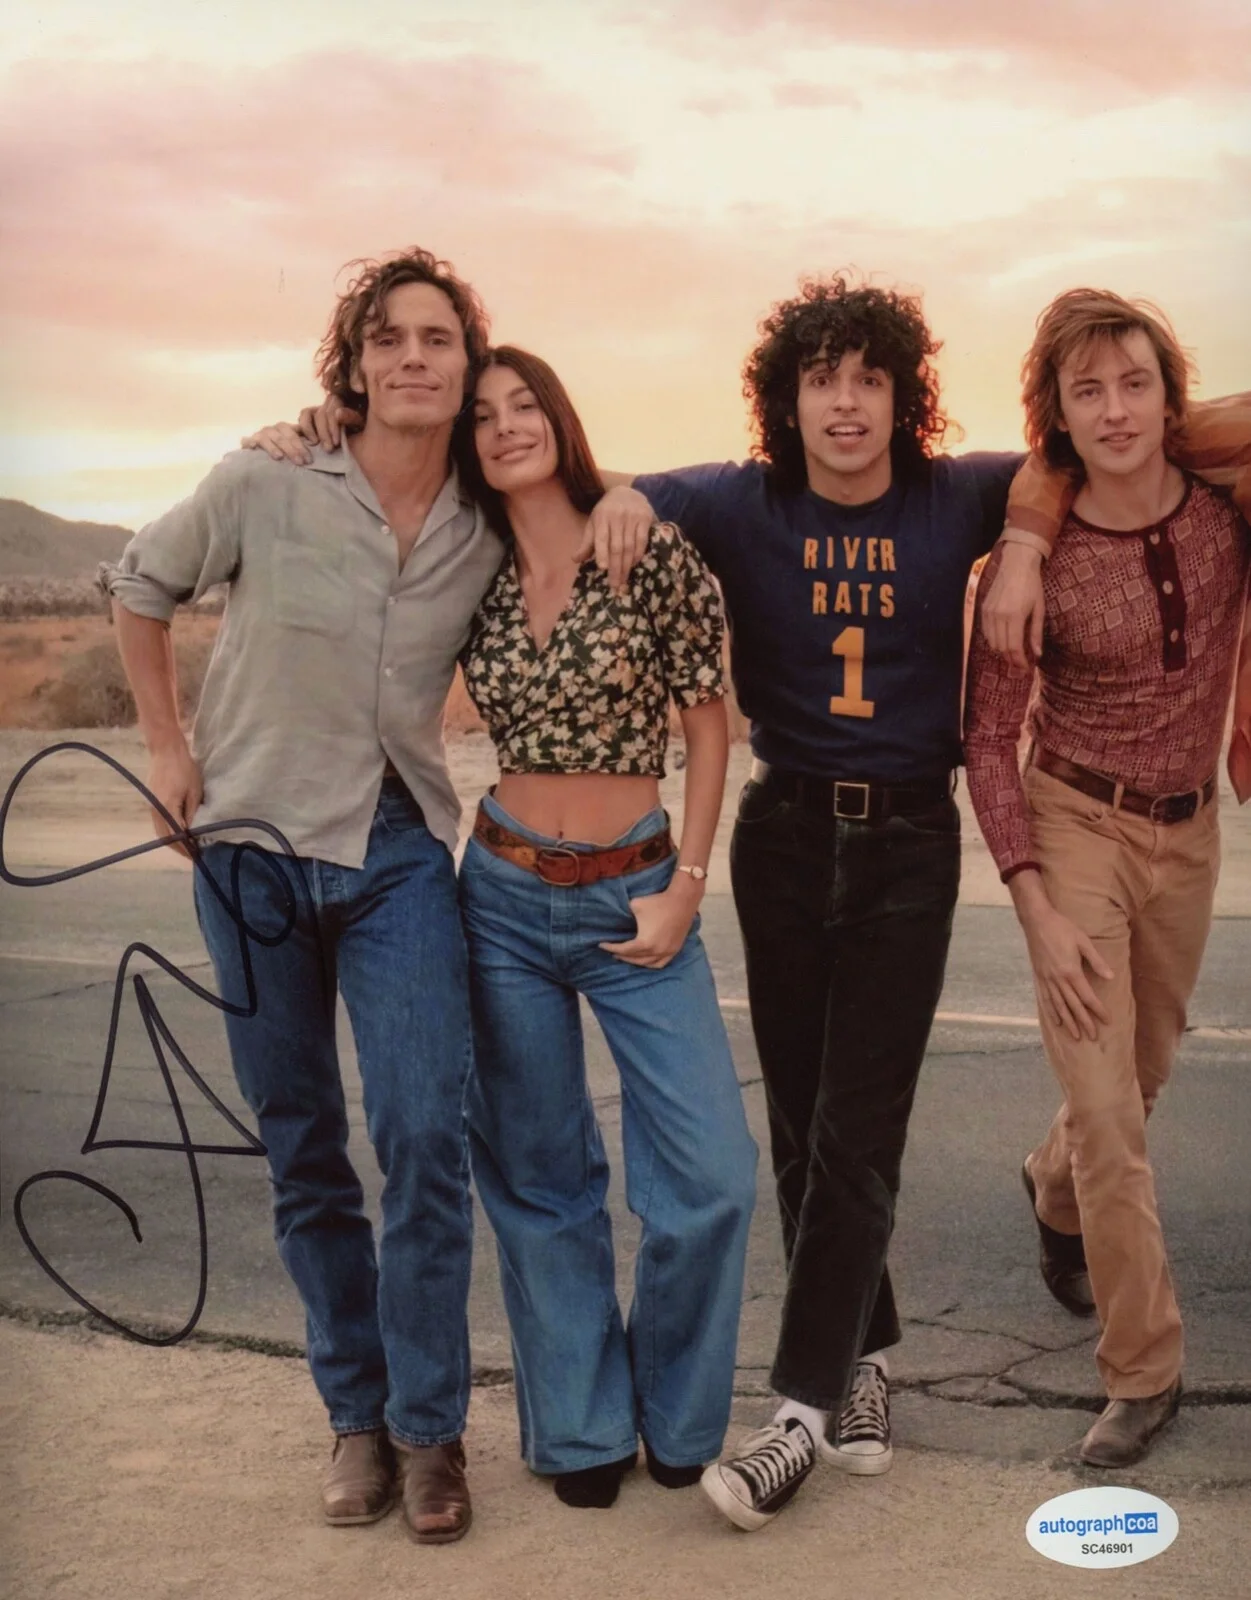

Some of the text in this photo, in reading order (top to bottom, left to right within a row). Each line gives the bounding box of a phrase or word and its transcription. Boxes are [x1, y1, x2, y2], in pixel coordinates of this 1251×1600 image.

[803, 536, 897, 572] RIVER
[812, 581, 896, 618] RATS
[829, 626, 875, 719] 1
[1081, 1543, 1134, 1555] SC46901
